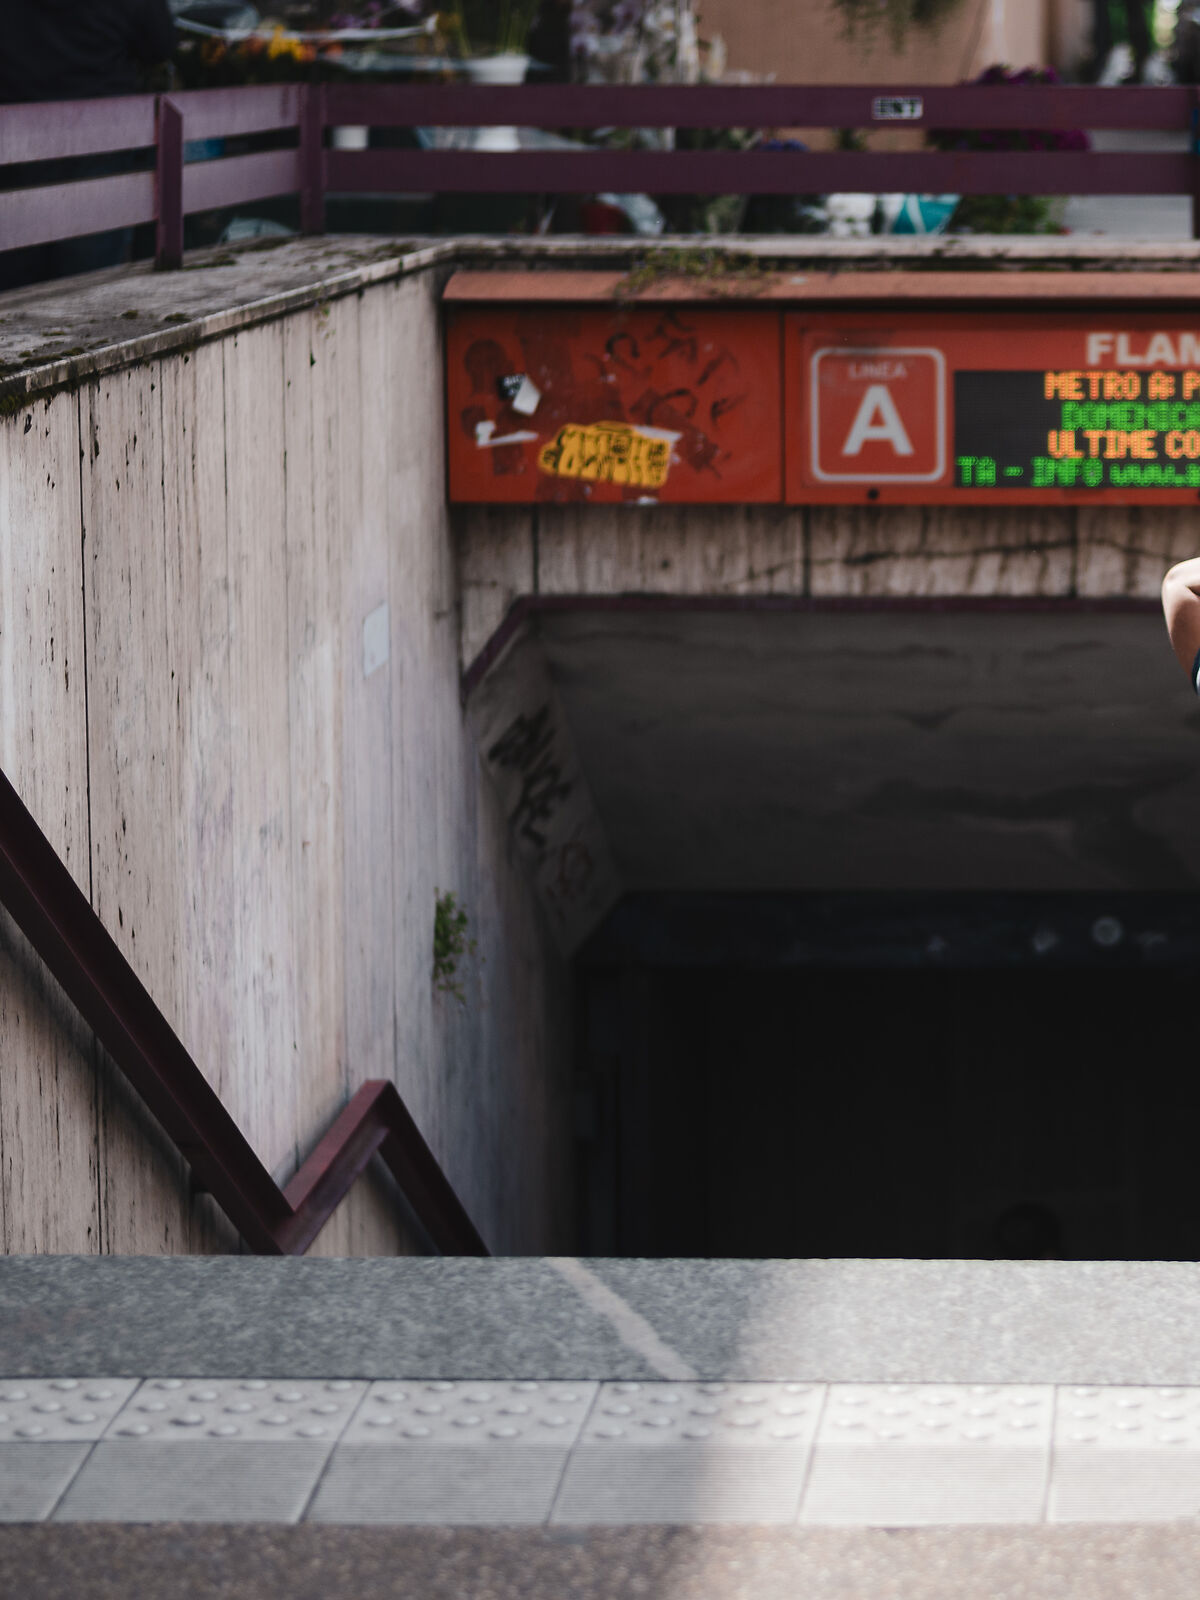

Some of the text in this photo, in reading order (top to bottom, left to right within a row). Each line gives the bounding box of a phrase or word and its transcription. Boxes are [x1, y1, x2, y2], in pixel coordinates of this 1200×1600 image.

[848, 361, 908, 379] LINEA
[1044, 371, 1141, 400] METRO
[842, 384, 914, 456] A
[1047, 430, 1158, 459] ULTIME
[1031, 456, 1103, 487] INFO
